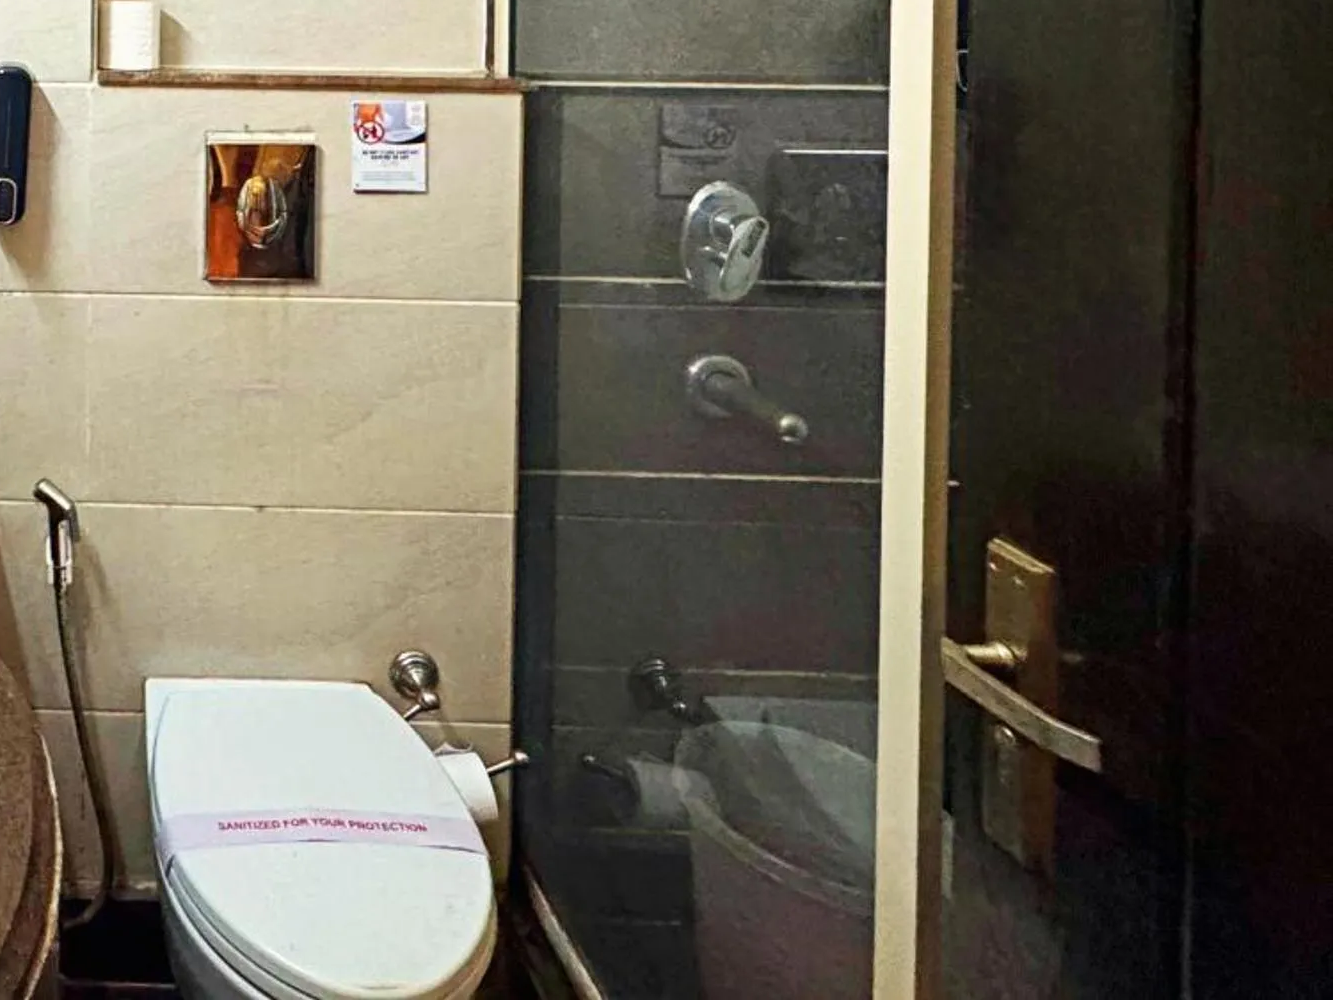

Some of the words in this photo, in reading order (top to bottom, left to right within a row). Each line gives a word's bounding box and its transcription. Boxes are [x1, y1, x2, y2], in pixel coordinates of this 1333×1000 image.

[218, 820, 280, 831] SANITIZED
[282, 818, 308, 828] FOR
[311, 817, 346, 828] YOUR
[348, 819, 428, 832] PROTECTION
